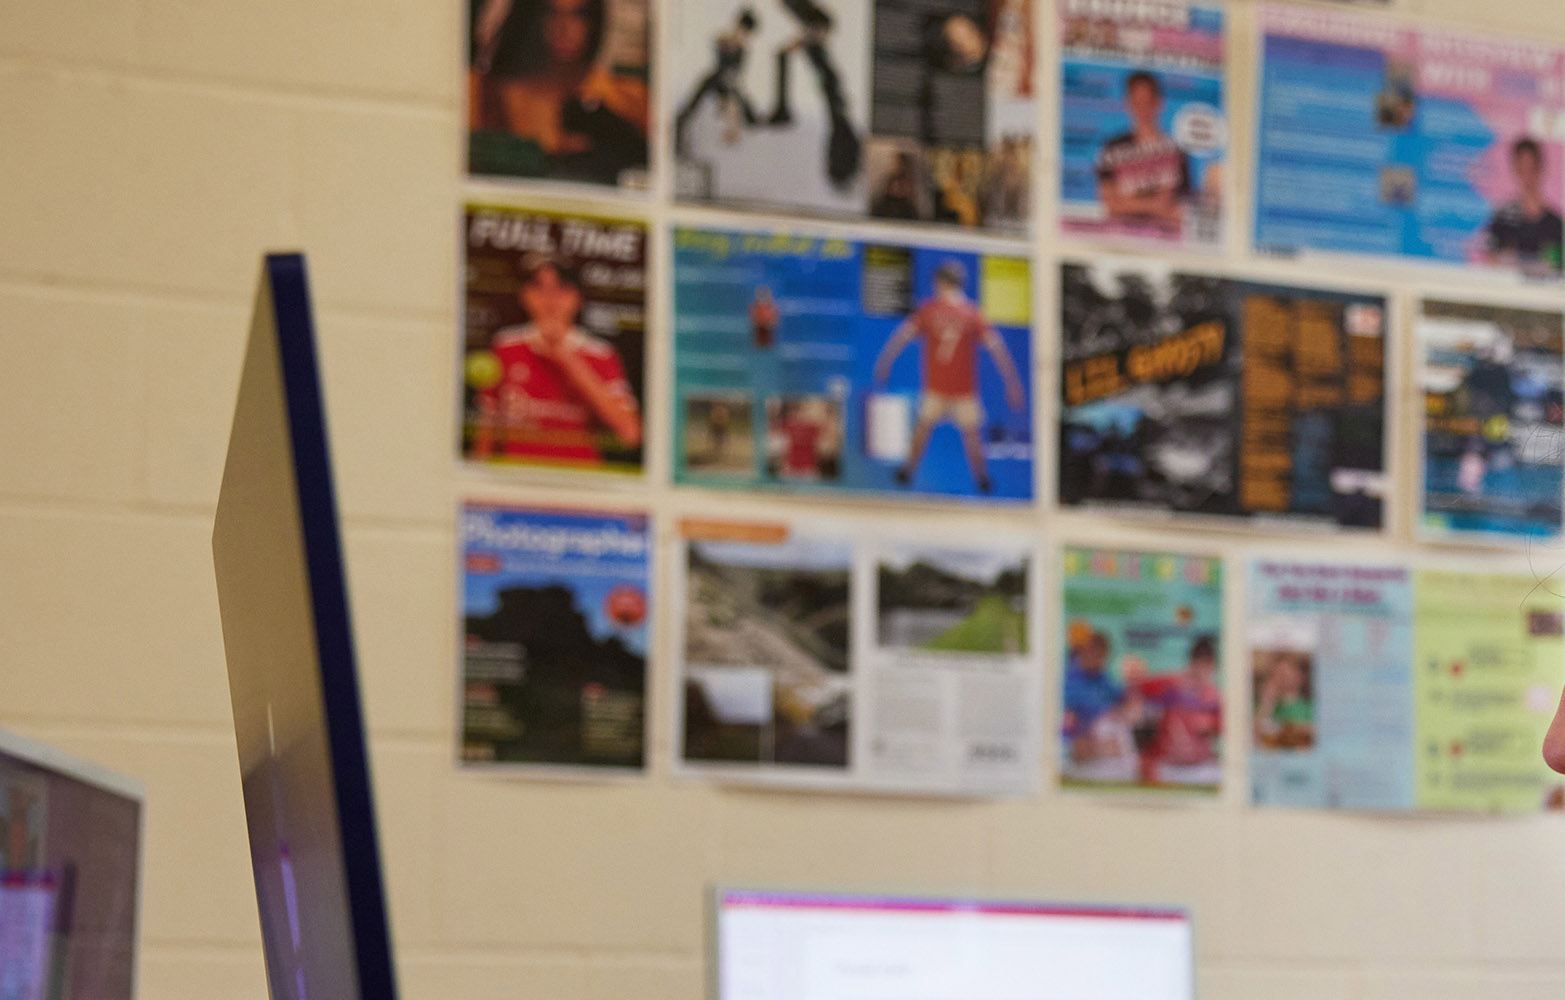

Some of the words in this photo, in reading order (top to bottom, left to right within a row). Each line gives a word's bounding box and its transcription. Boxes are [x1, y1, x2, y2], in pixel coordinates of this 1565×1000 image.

[473, 217, 551, 249] FULL
[563, 224, 638, 258] TIME
[460, 518, 646, 556] Photographer
